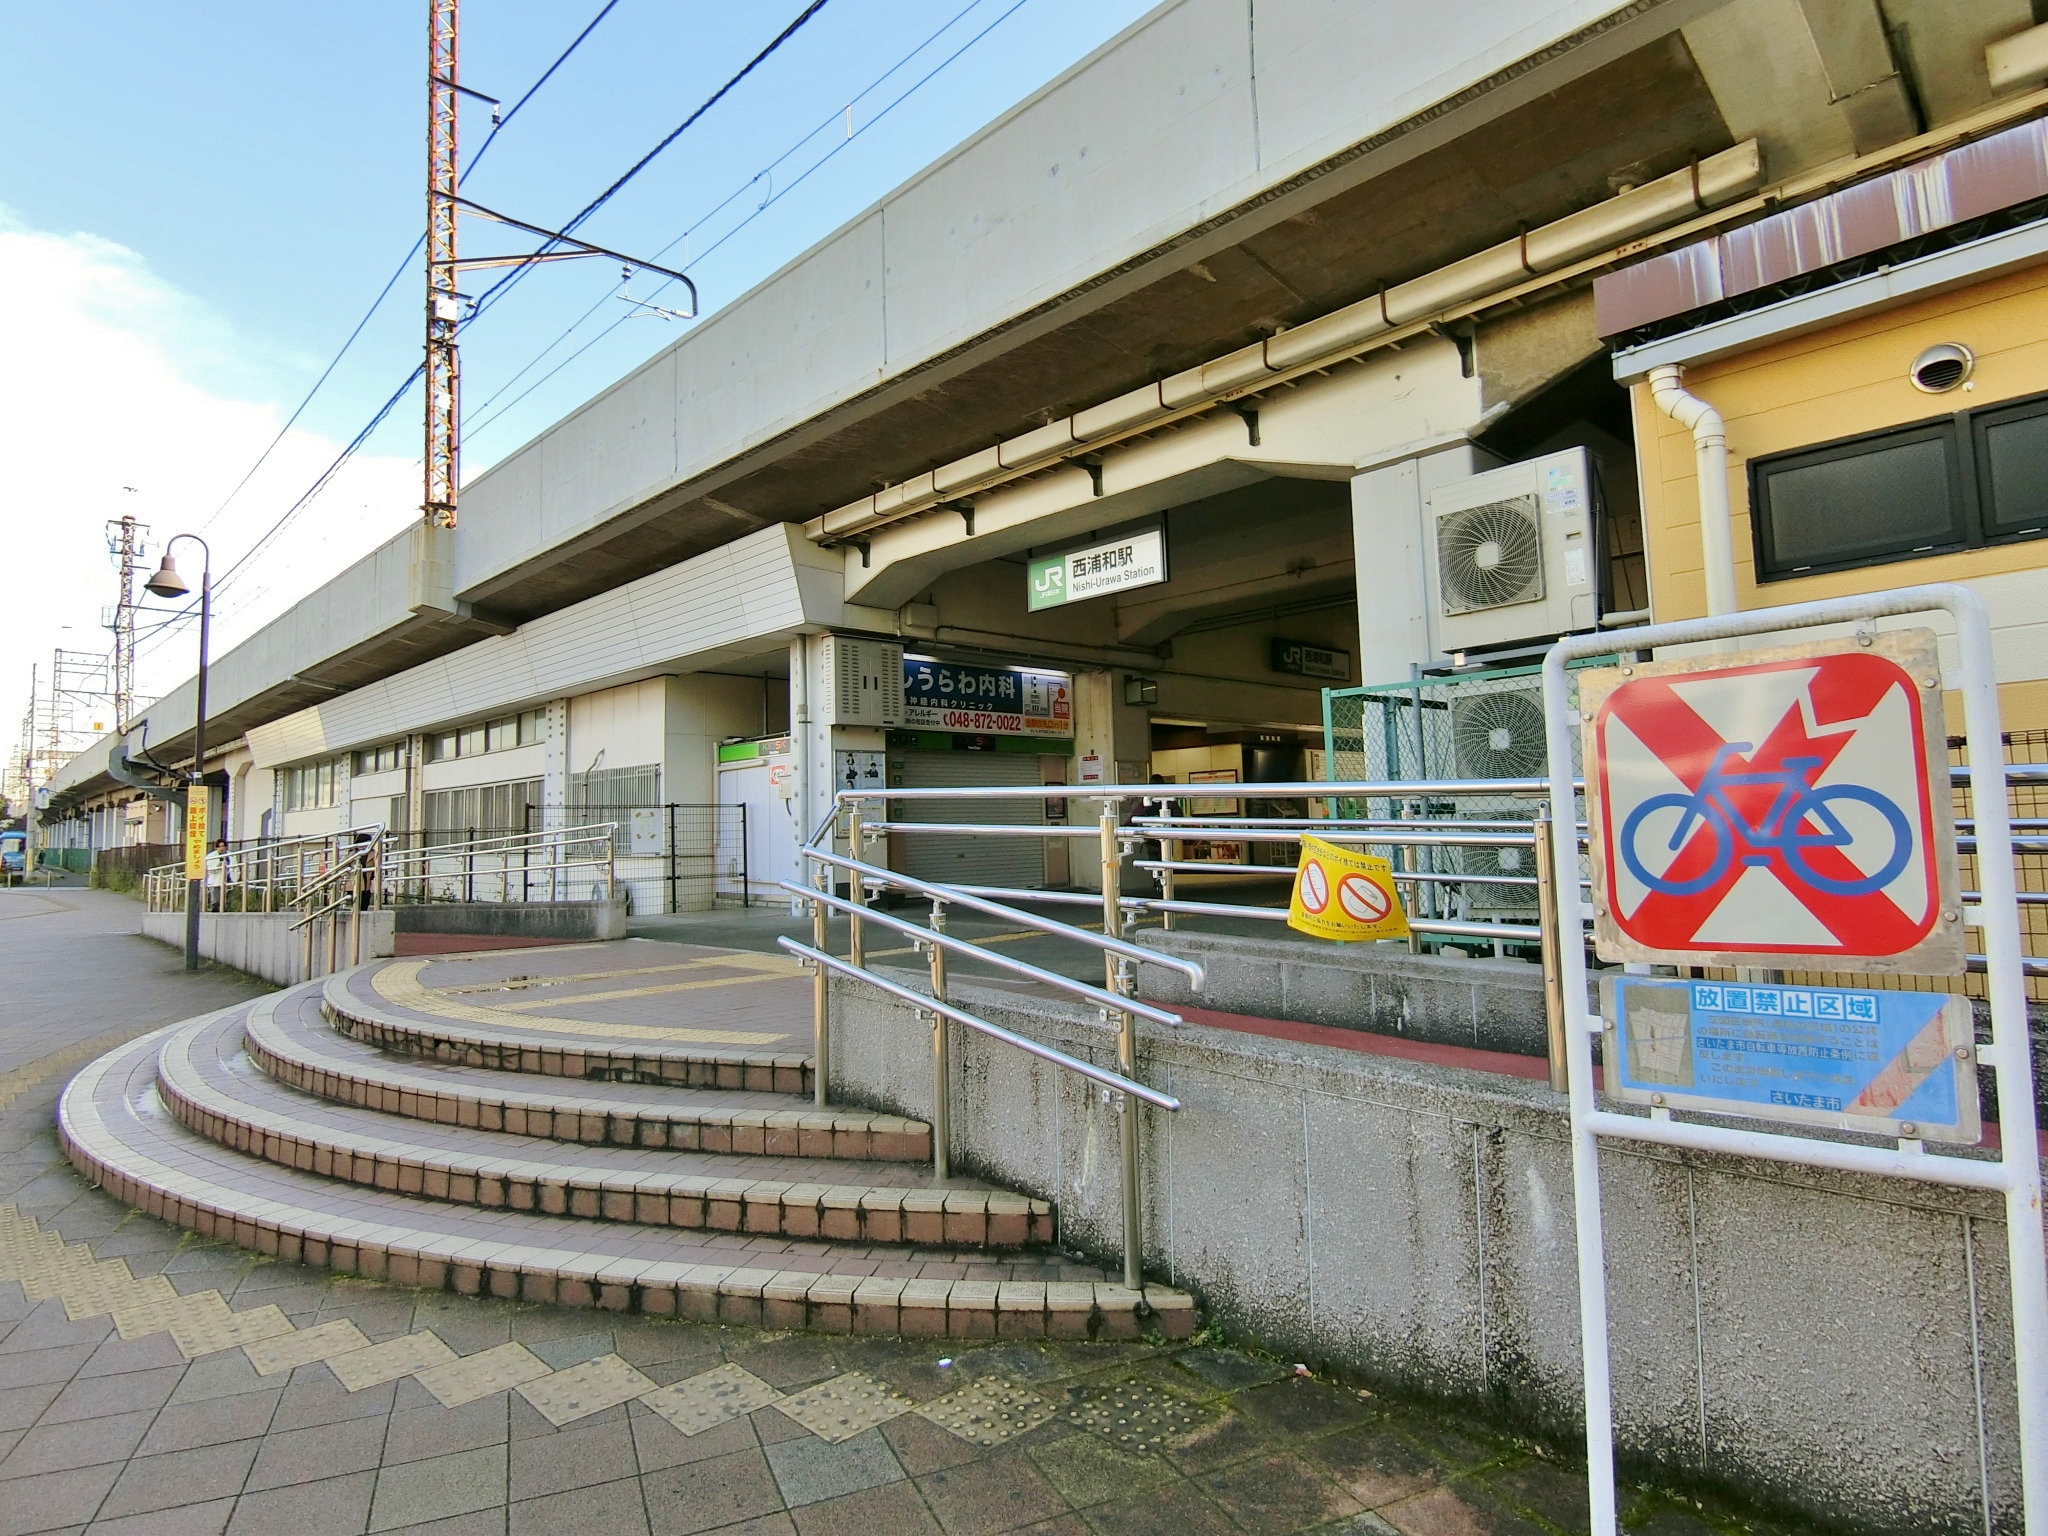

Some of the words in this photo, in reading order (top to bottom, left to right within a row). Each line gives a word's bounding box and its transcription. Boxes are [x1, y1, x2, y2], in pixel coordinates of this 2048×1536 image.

[1072, 545, 1133, 579] 西浦和駅
[1035, 565, 1063, 592] JR
[1072, 574, 1122, 593] Nishi-Urawa
[1123, 565, 1155, 580] Station
[1283, 647, 1301, 664] JR
[904, 695, 993, 711] 神経内科クリニック
[949, 711, 1021, 732] 048-872-0022
[762, 740, 787, 751] KIOSK
[193, 839, 202, 870] やめましょう
[1696, 988, 1874, 1019] 放置禁止区域
[1772, 1092, 1840, 1110] さいたま市
